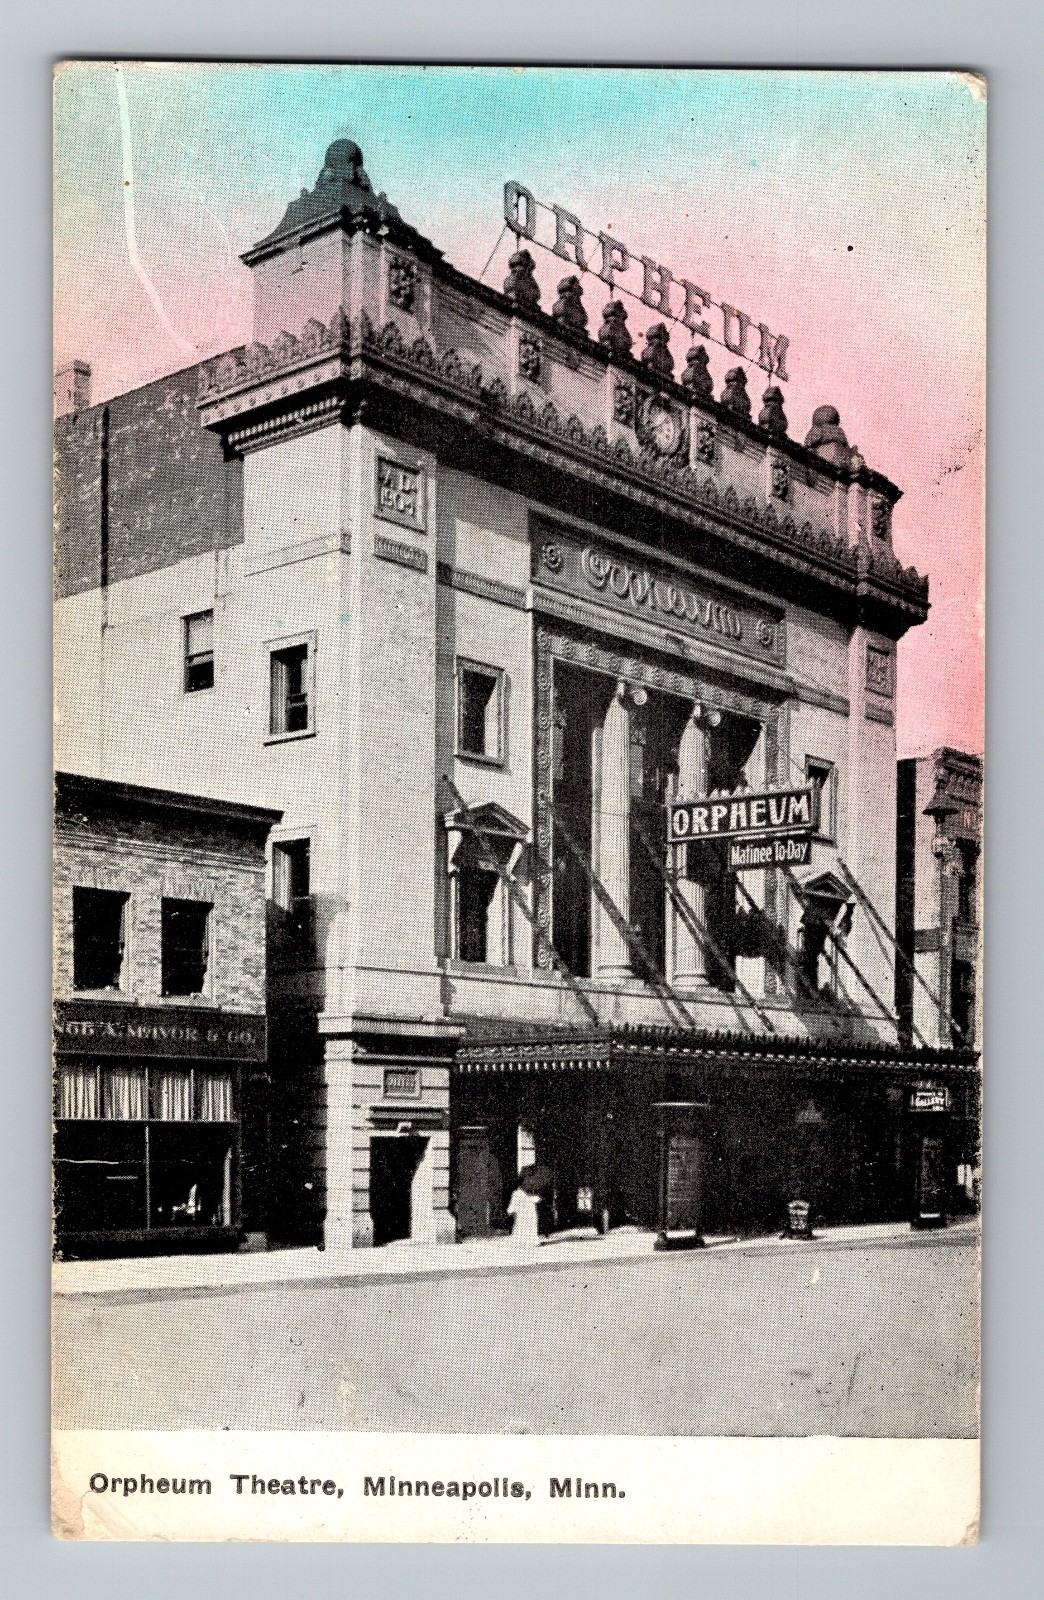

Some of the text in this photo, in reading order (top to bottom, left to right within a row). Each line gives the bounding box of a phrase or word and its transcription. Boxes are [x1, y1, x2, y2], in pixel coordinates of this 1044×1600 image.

[504, 180, 789, 382] ORPHEUM
[672, 794, 810, 836] ORPHEUM
[731, 844, 772, 865] Matinee
